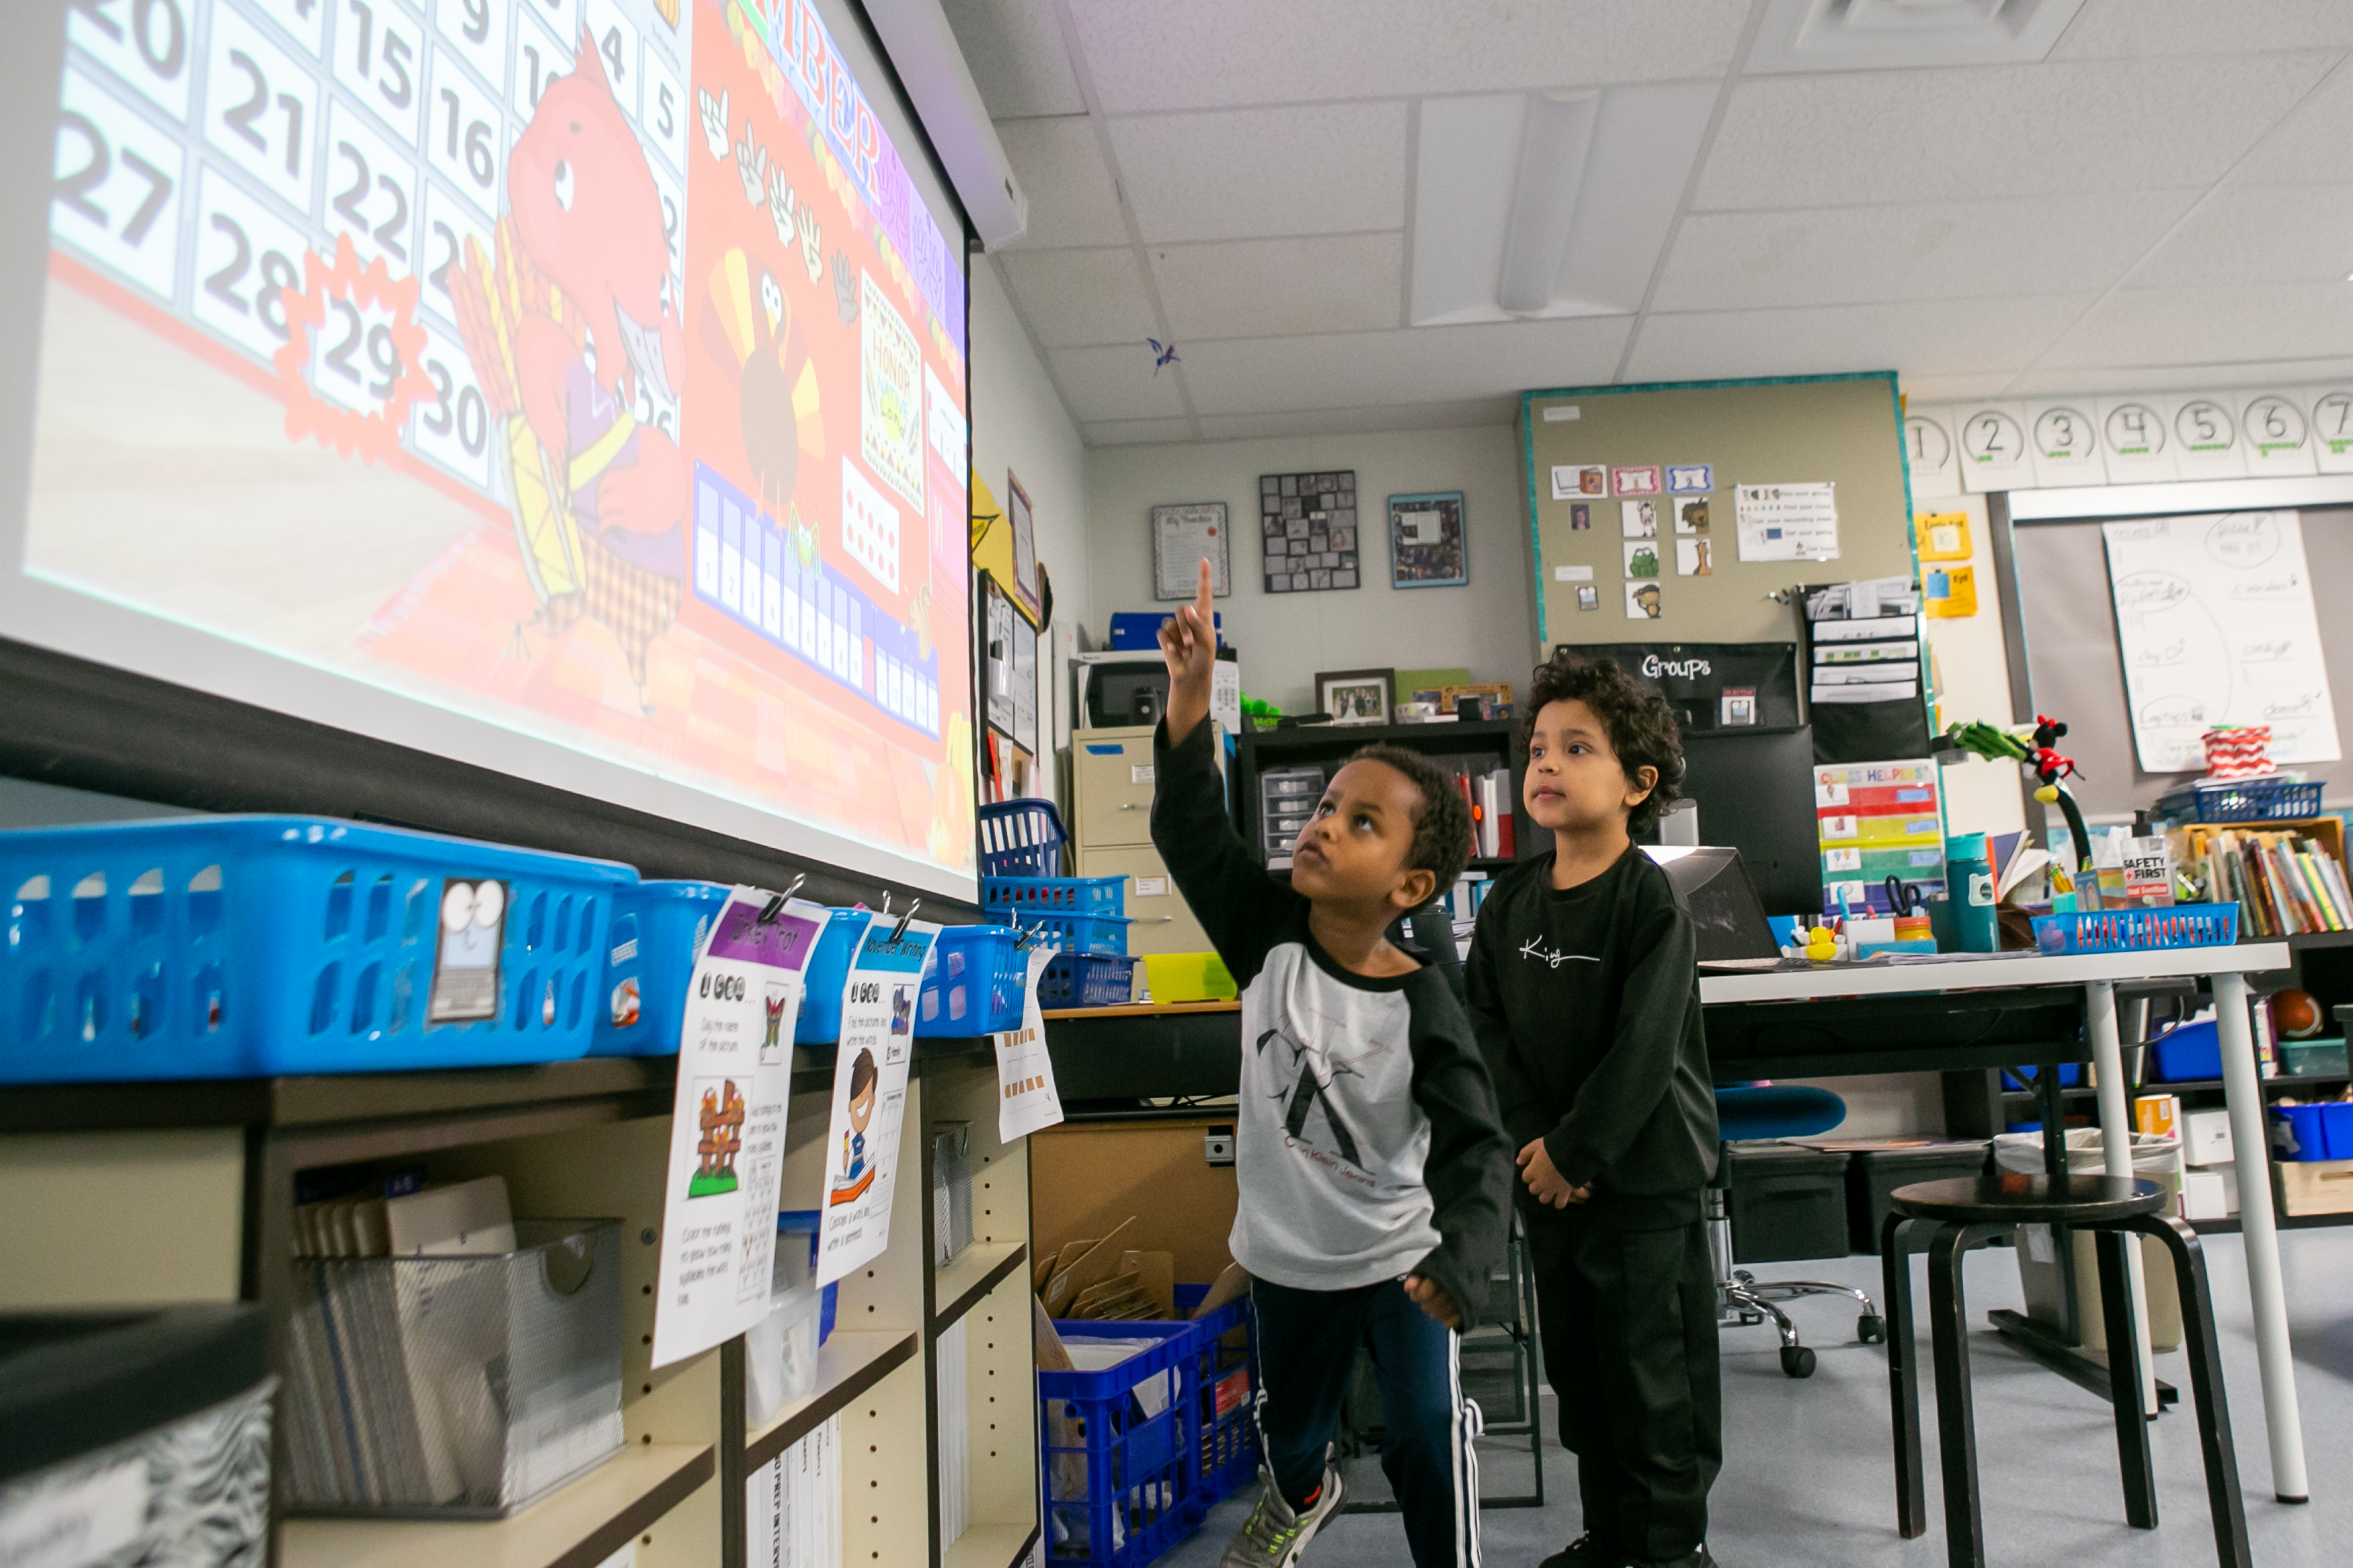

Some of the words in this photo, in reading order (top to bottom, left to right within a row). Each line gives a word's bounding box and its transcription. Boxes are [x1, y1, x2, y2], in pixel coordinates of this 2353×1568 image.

[463, 0, 489, 44] 9
[351, 0, 412, 110] 15
[602, 25, 625, 85] 4
[223, 48, 303, 179] 21
[441, 88, 494, 188] 16
[657, 81, 674, 139] 5
[53, 109, 173, 248] 27
[333, 140, 407, 264] 22
[204, 212, 299, 339] 28
[325, 296, 402, 400] 29
[873, 329, 910, 402] HONOR
[423, 359, 487, 458] 30
[877, 374, 909, 423] NATIVE
[1913, 426, 1926, 458] 1
[1983, 419, 2003, 450] 2
[2055, 415, 2074, 446] 3
[2122, 412, 2145, 442] 4
[2191, 407, 2217, 440] 5
[2264, 405, 2287, 438] 6
[2326, 401, 2353, 434] 7
[1642, 654, 1712, 681] Groups
[1821, 770, 1862, 784] CLASS
[1867, 768, 1923, 782] HELPERS
[2124, 856, 2165, 869] SAFETY
[2135, 868, 2166, 879] FIRST
[864, 935, 901, 956] November
[900, 940, 926, 962] Writing
[1310, 1149, 1339, 1171] Klein
[1341, 1166, 1376, 1188] Jeans
